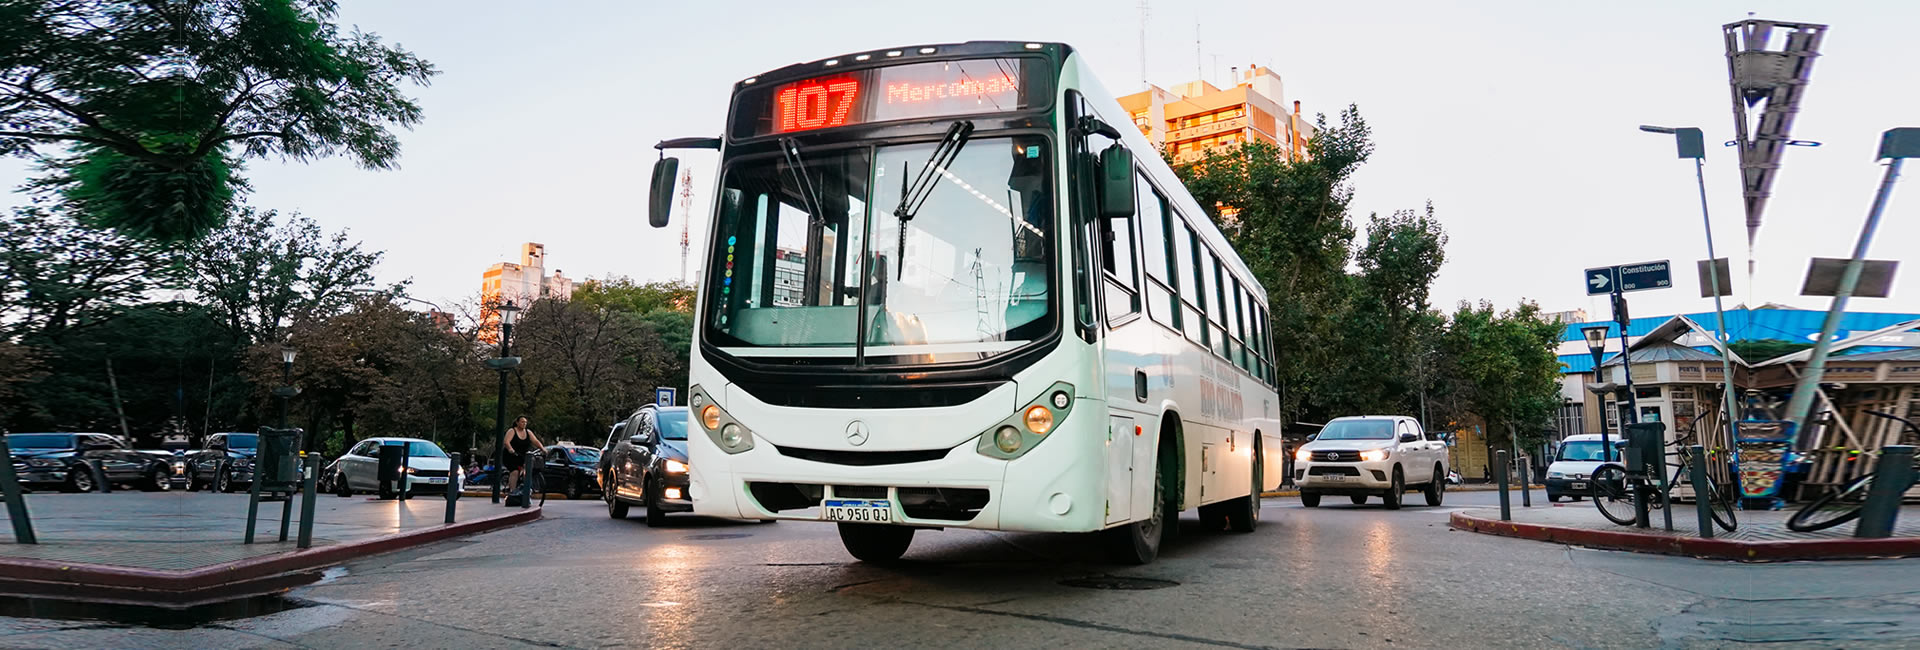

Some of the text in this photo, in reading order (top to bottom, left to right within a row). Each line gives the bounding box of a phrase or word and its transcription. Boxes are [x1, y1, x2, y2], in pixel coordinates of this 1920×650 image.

[779, 74, 1017, 131] 107 Mercomax
[1622, 264, 1665, 274] Constitución
[829, 508, 888, 521] AC 950 QJ
